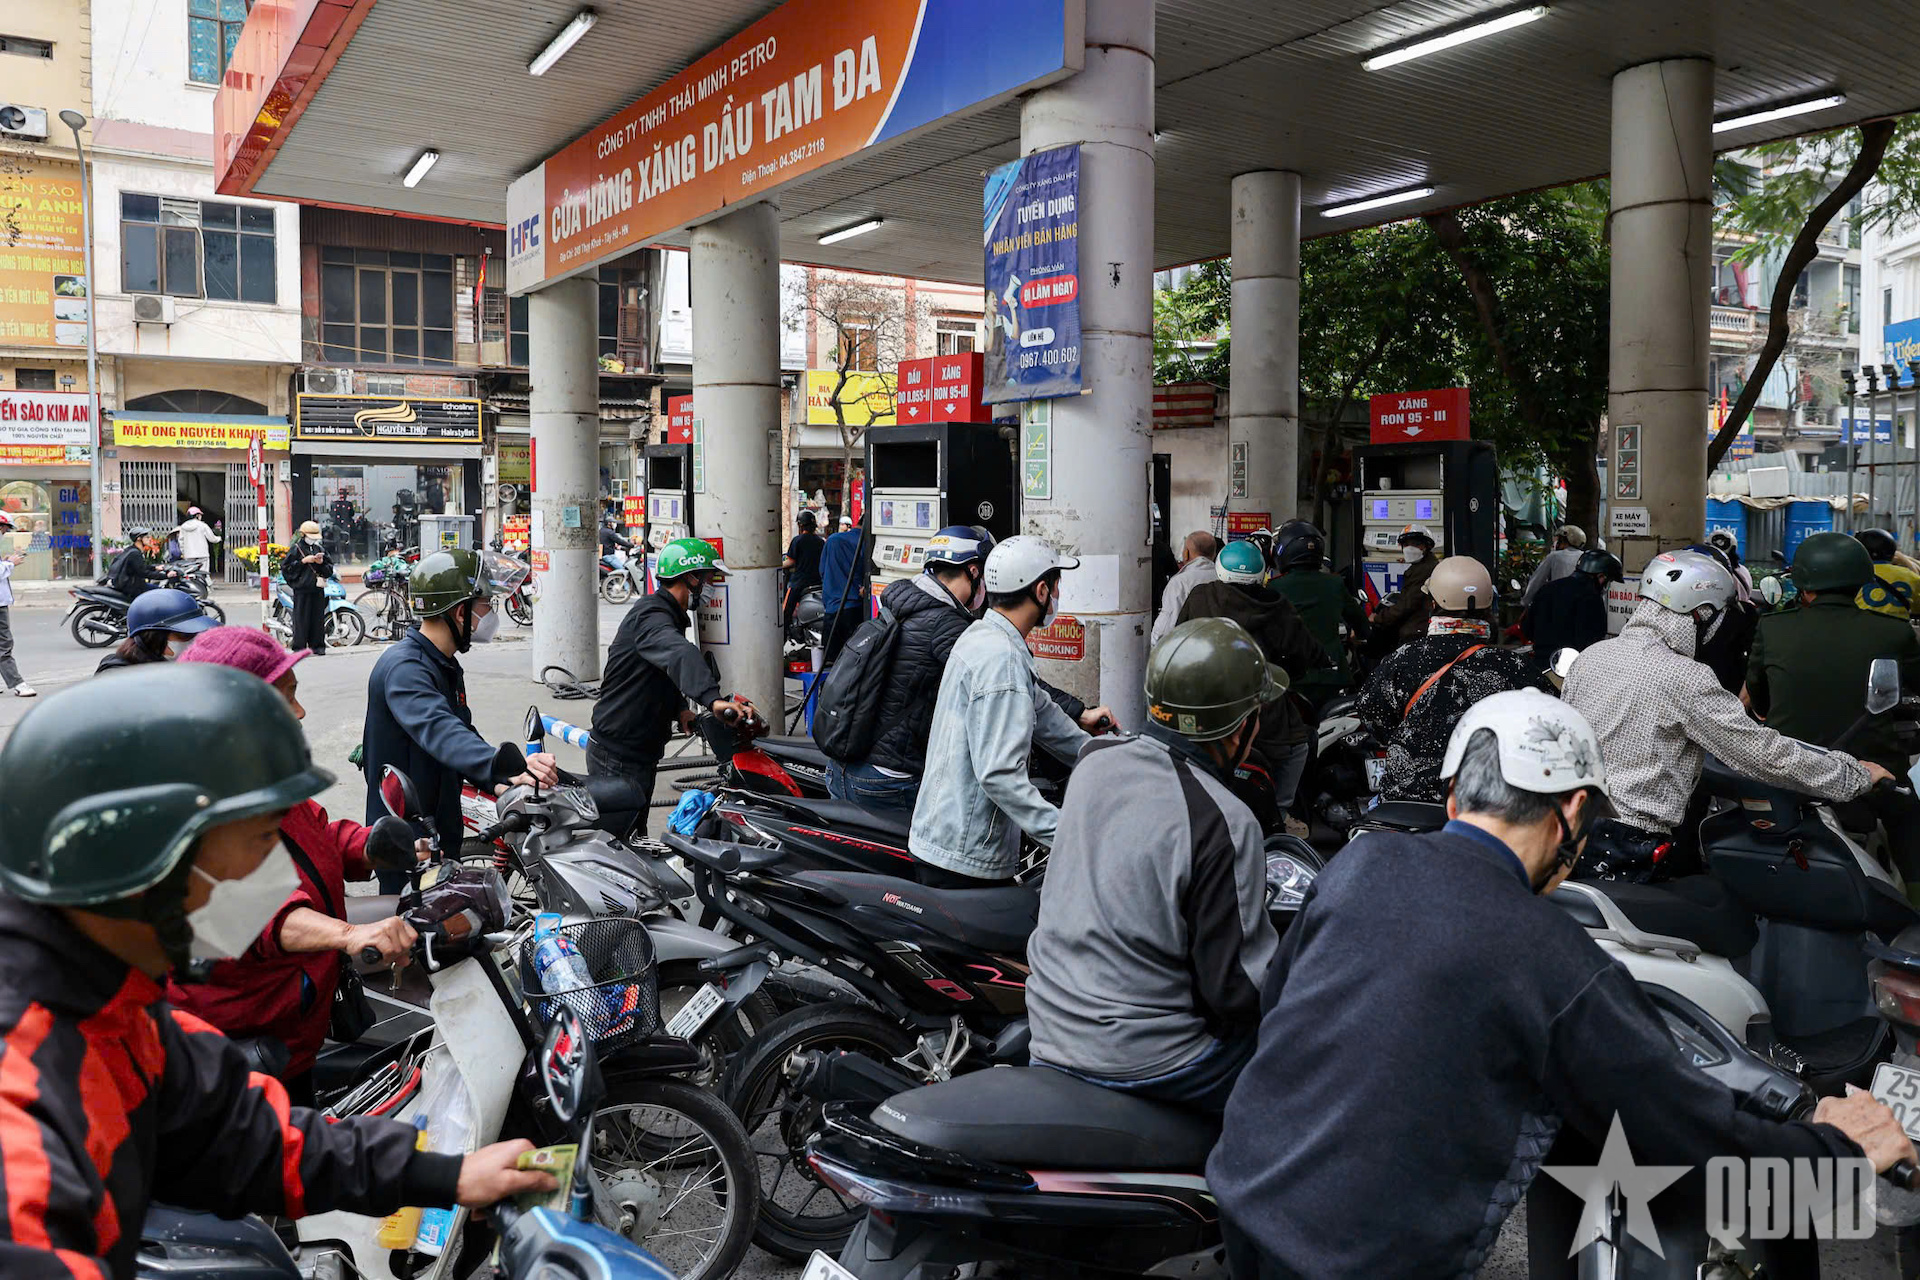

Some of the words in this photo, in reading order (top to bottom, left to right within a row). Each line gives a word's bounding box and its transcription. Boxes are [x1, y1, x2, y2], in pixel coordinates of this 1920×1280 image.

[598, 130, 624, 159] CÔNG
[625, 120, 637, 143] TY
[640, 101, 667, 134] TNHH
[669, 84, 695, 117] THÁI
[698, 65, 728, 102] MINH
[731, 36, 777, 82] PETRO
[551, 188, 582, 244] CỬA
[586, 168, 632, 229] HÀNG
[637, 134, 696, 203] XĂNG
[703, 94, 753, 173] DẦU
[761, 63, 822, 144] TAM
[833, 35, 882, 112] ĐA
[742, 170, 757, 185] Điện
[779, 137, 825, 169] 04.3847.2118
[37, 198, 83, 215] ANH
[1048, 194, 1075, 219] DỤNG
[511, 213, 540, 258] HFC
[993, 236, 1015, 257] NHÂN
[1015, 231, 1033, 251] VIÊN
[1034, 227, 1052, 246] BÁN
[1054, 222, 1078, 243] HÀNG
[1032, 282, 1051, 301] LÀM
[1053, 280, 1075, 298] NGAY
[1020, 346, 1077, 369] 0967.400.602
[941, 365, 962, 381] XĂNG
[819, 385, 831, 393] BIA
[933, 386, 949, 401] RON
[949, 384, 969, 400] 95-III
[809, 394, 822, 407] HÀ
[1398, 398, 1428, 411] XĂNG
[20, 400, 44, 421] SÀO
[47, 404, 69, 422] KIM
[72, 405, 90, 423] AN
[1380, 412, 1406, 426] RON
[1408, 412, 1423, 424] 95
[1433, 410, 1447, 422] III
[122, 422, 148, 439] MẬT
[152, 425, 176, 438] ONG
[229, 429, 266, 440] KHANG
[441, 427, 475, 439] Hairstylist
[1624, 511, 1641, 520] MÁY
[678, 553, 706, 567] Grab
[711, 612, 722, 622] MÁY
[1054, 622, 1082, 639] THUỐC
[1038, 643, 1079, 655] SMOKING
